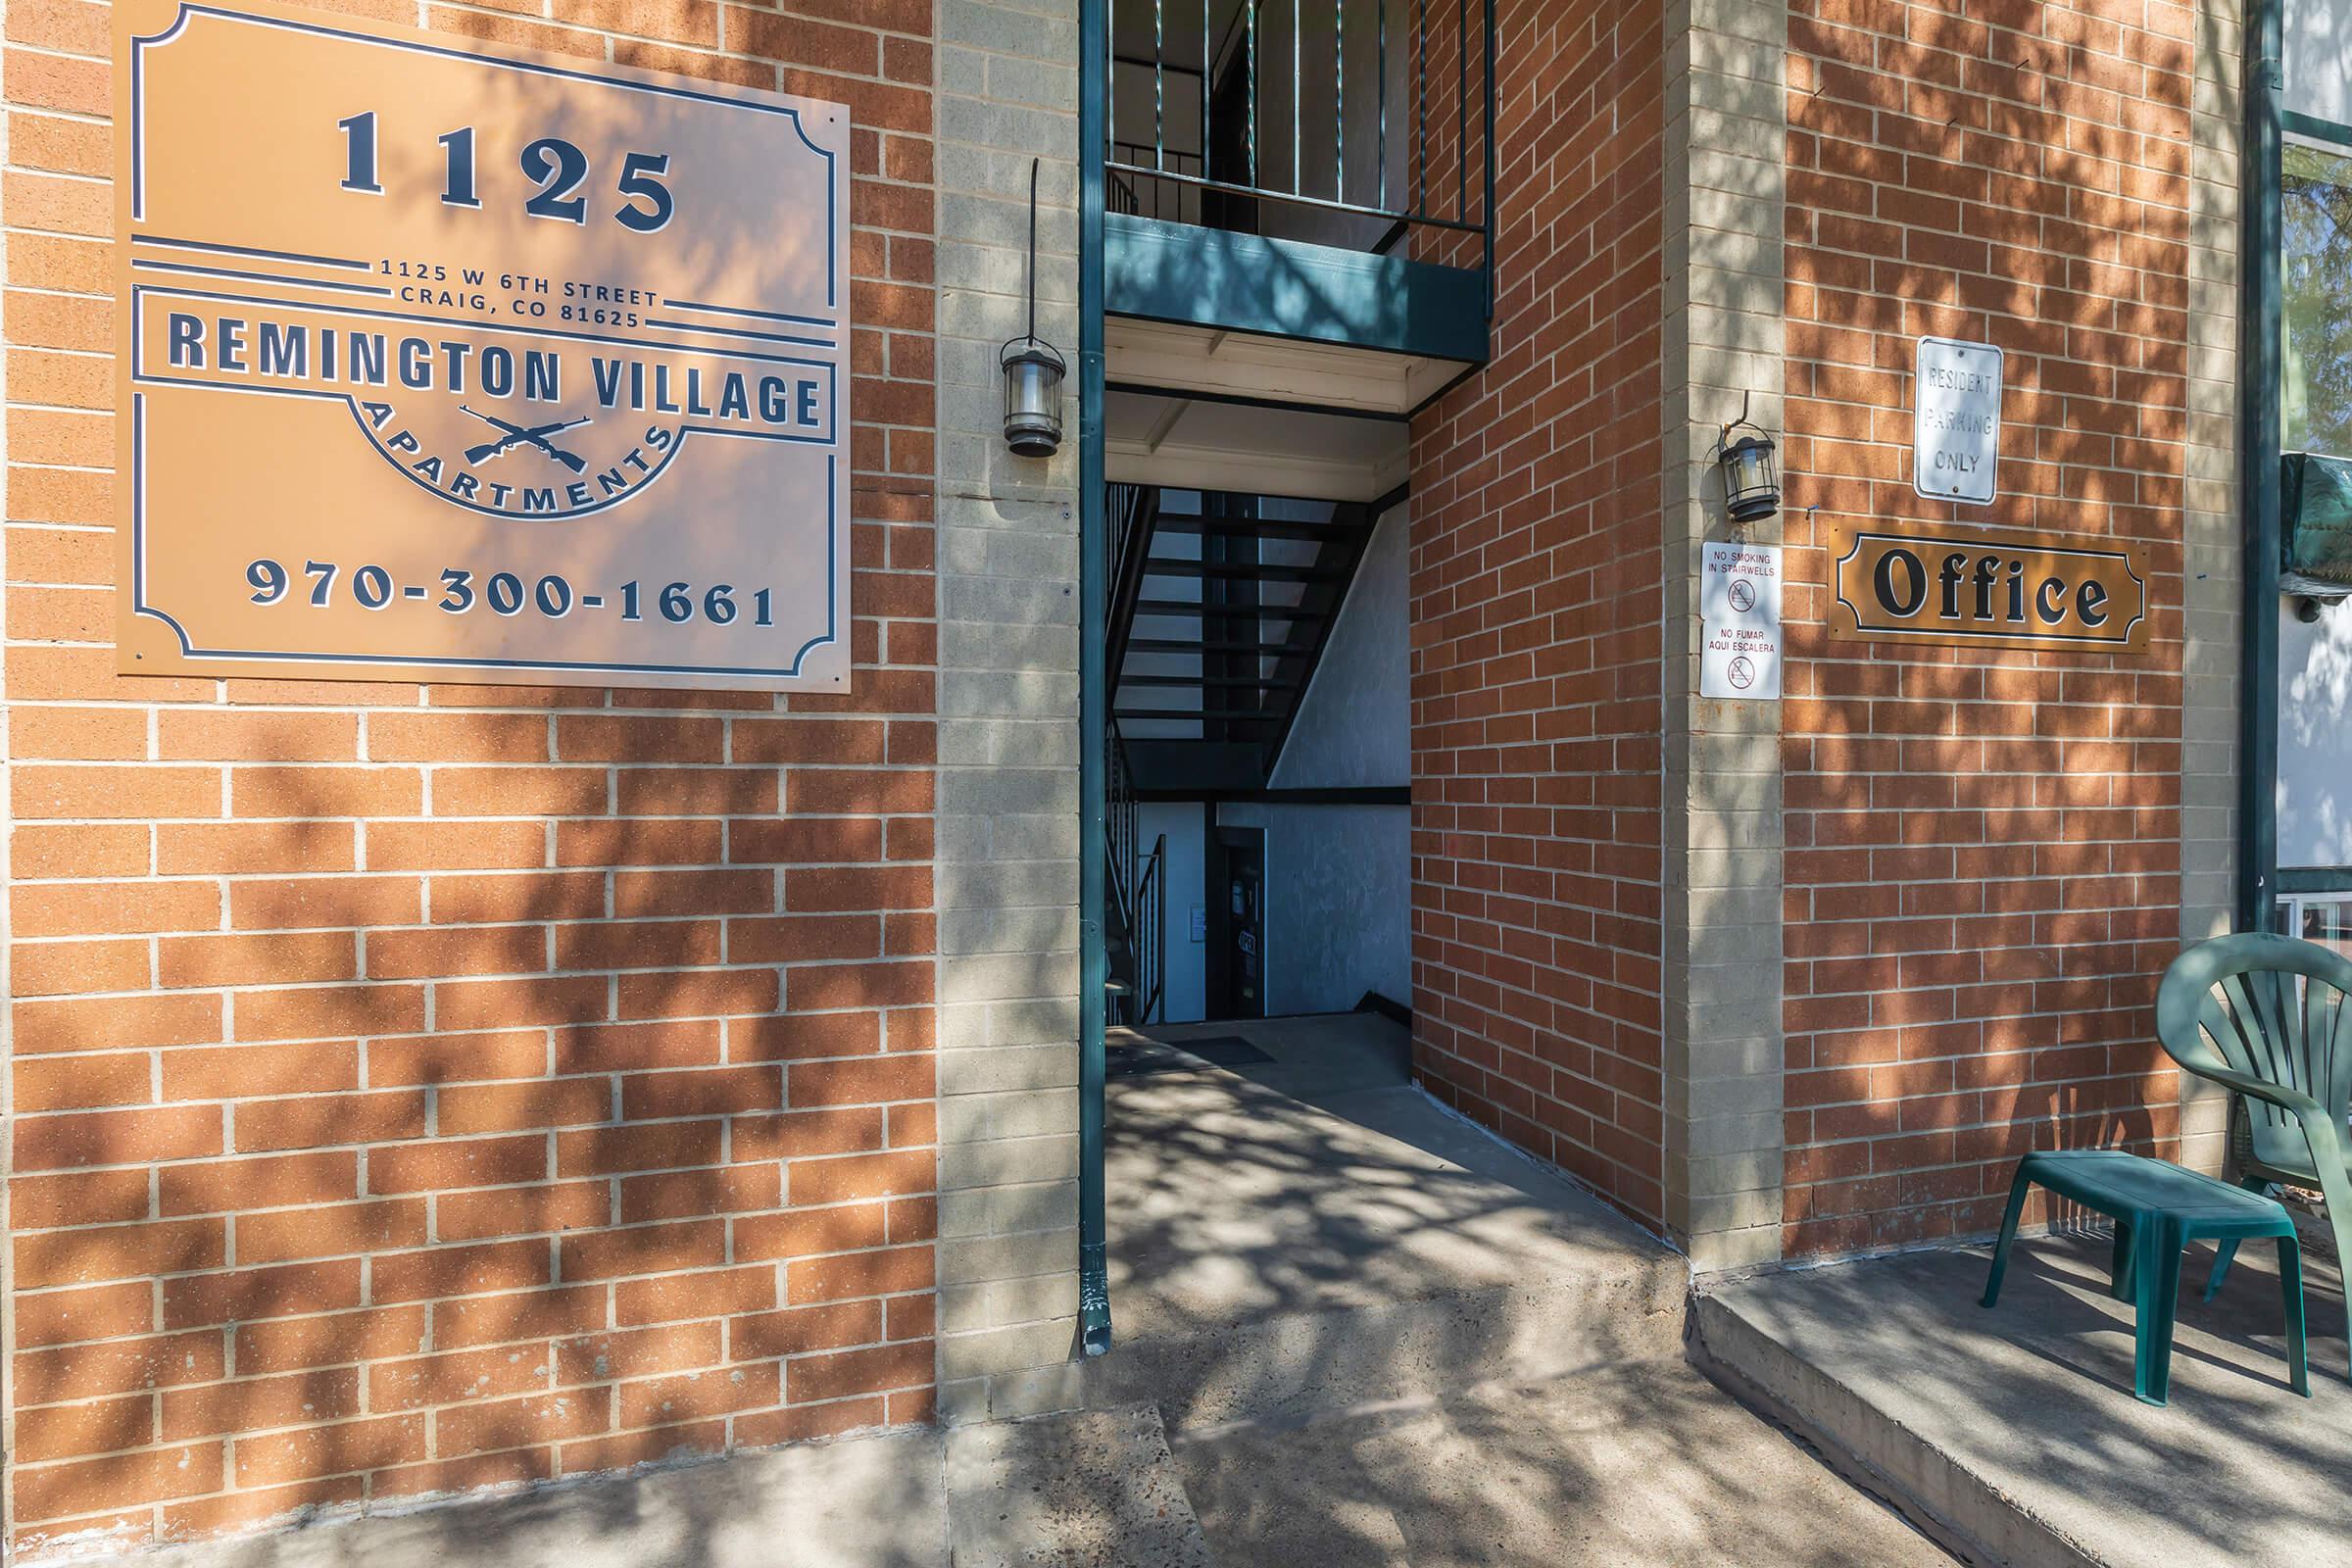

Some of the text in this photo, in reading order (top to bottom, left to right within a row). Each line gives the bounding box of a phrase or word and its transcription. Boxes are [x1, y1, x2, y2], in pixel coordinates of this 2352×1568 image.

[336, 111, 675, 235] 1125
[380, 259, 658, 307] 1125 W 6TH STREET
[400, 286, 639, 328] CRAIG, CO 81625
[169, 313, 821, 428] REMINGTON VILLAGE
[1928, 368, 1992, 395] RESIDENT
[1925, 407, 1992, 435] PARKING
[362, 400, 673, 512] APARTMENTS
[1935, 451, 1981, 473] ONLY
[1708, 564, 1775, 576] IN STAIRWELLS
[1714, 551, 1771, 564] NO SMOKING
[246, 559, 775, 628] 970-300-1661
[1873, 548, 2109, 628] Office
[1708, 641, 1775, 653] AQUI ESCALERA
[1720, 629, 1764, 640] NO FUMAR
